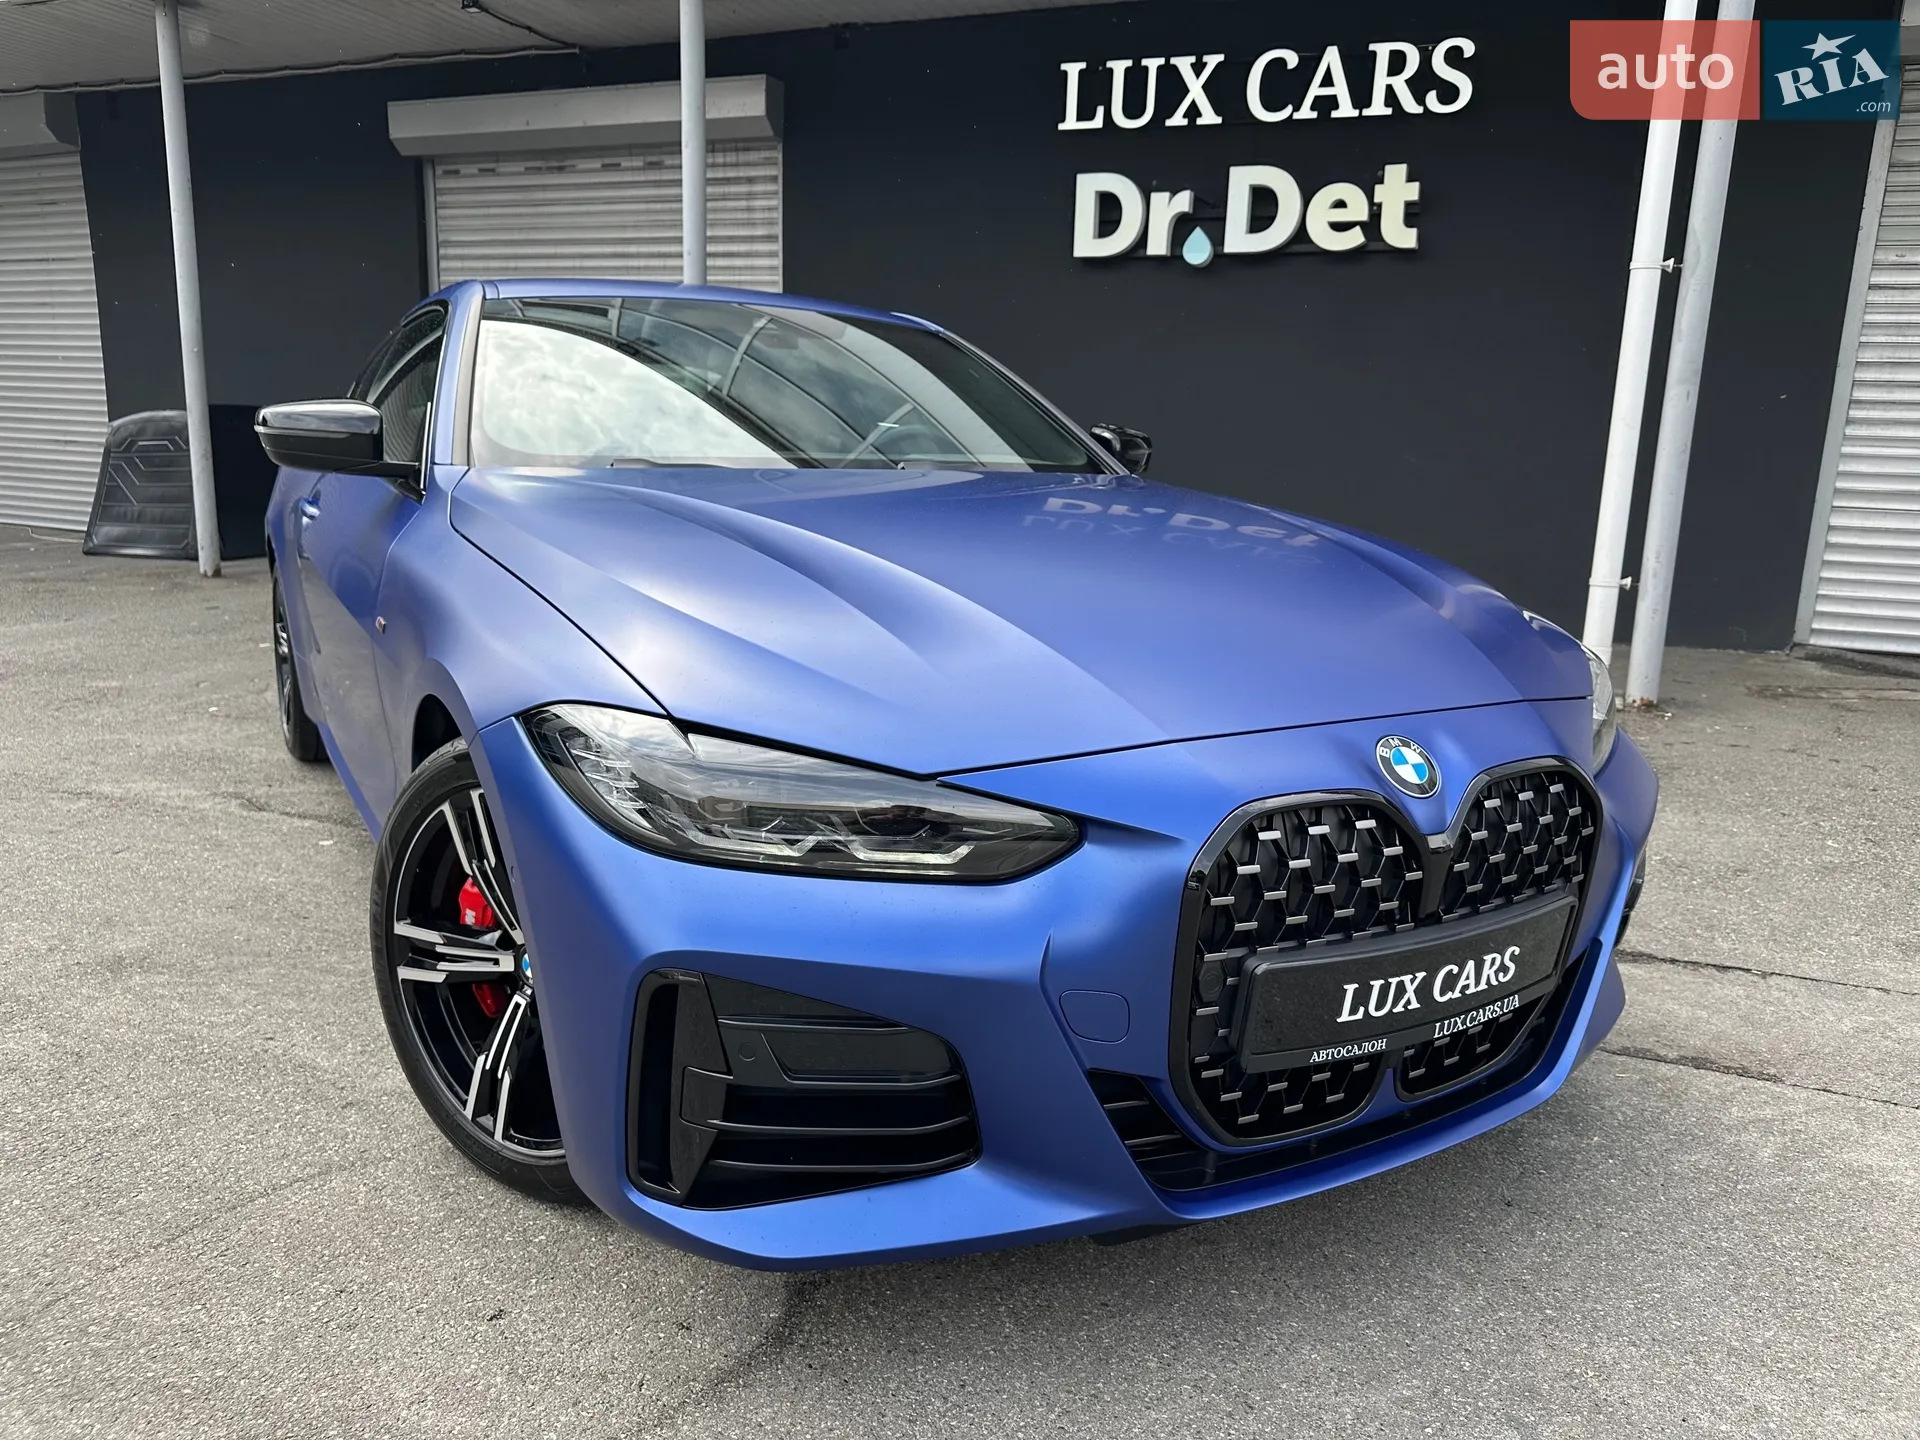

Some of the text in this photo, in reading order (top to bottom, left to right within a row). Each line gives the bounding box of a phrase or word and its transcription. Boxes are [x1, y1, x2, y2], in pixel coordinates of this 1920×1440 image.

[1057, 36, 1476, 131] LUX CARS
[1378, 737, 1421, 759] BMW
[1336, 945, 1521, 1023] LUX CARS
[1432, 994, 1520, 1039] LUX.CARS.UA
[1309, 1038, 1388, 1063] АВТОСАЛОН
